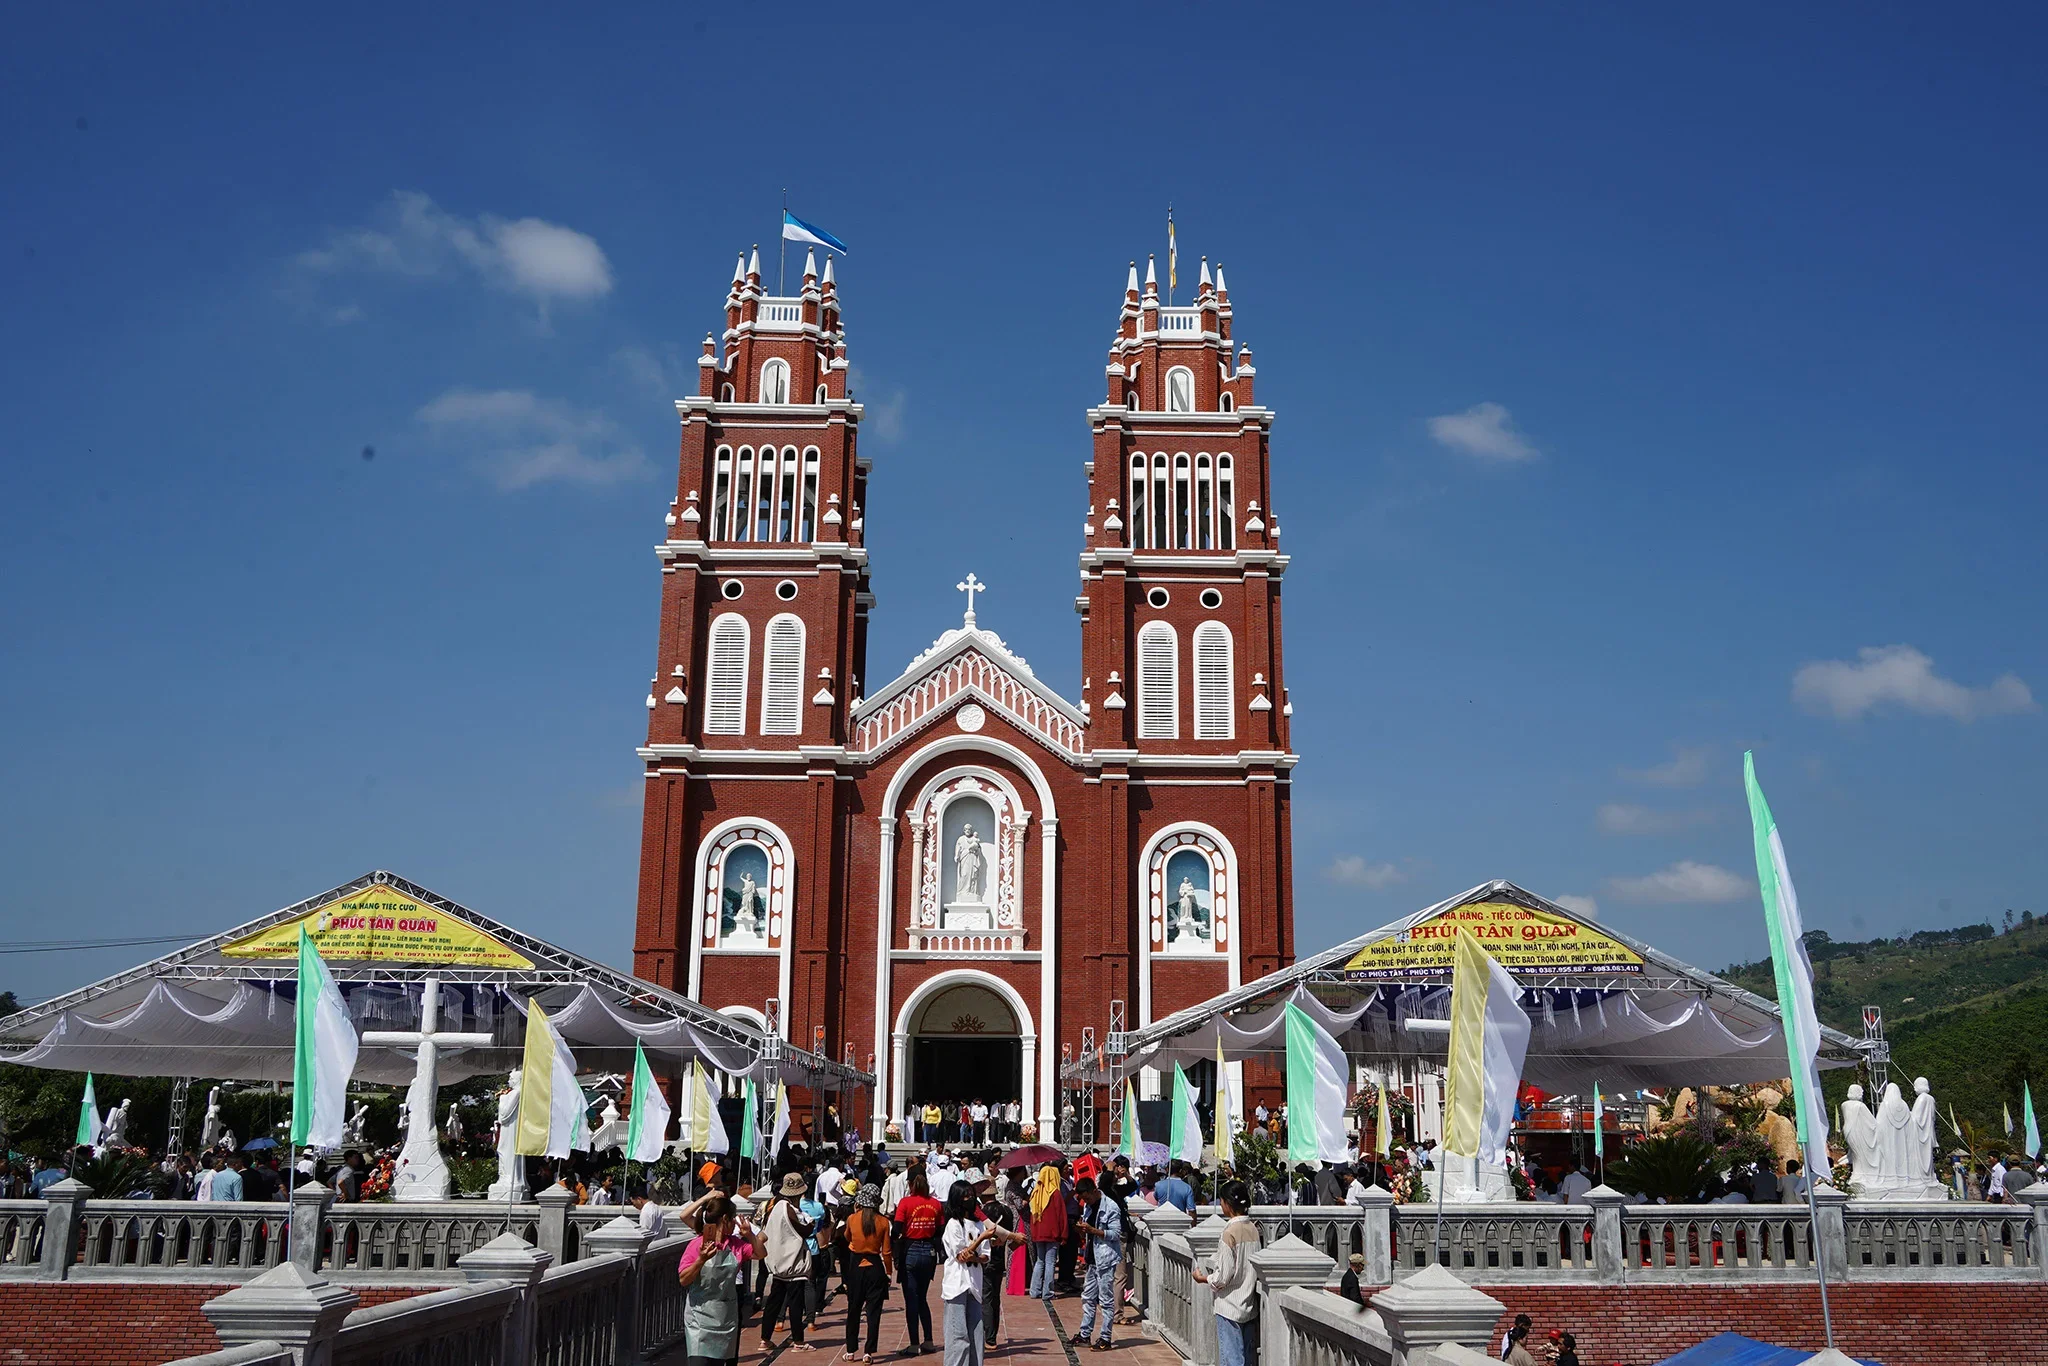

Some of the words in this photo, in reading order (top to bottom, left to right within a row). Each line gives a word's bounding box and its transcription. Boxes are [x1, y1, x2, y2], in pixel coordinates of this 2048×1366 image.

[331, 914, 366, 930] PHÚC
[368, 914, 395, 931] TÂN
[398, 916, 438, 933] QUÁN
[1460, 910, 1484, 920] HÀNG
[1492, 910, 1512, 922] TIỆC
[1474, 922, 1514, 938] TÂN
